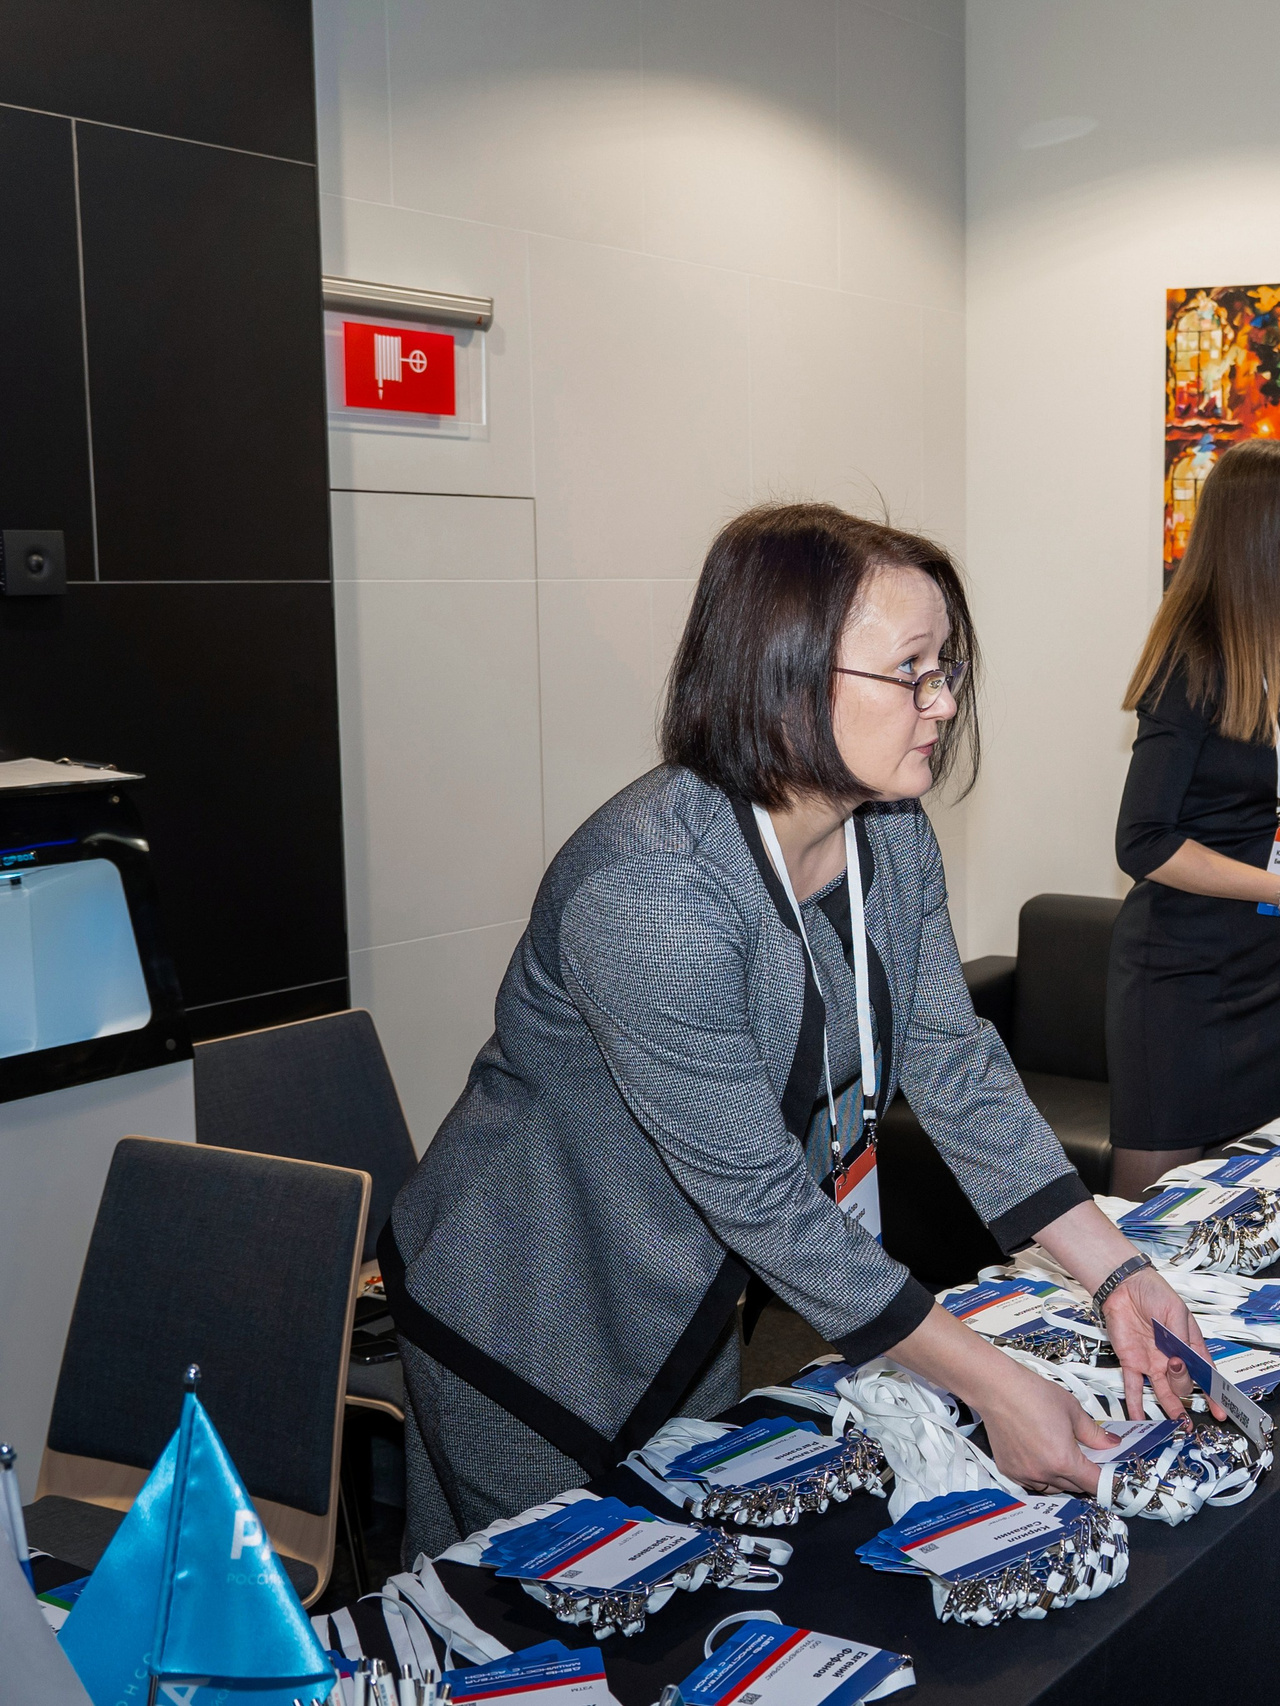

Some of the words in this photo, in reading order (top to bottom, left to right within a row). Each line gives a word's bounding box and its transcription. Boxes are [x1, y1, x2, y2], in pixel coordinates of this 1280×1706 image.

[774, 1441, 819, 1460] Рагозина
[993, 1520, 1042, 1541] Сабанин
[1007, 1525, 1050, 1543] Кирилл
[628, 1535, 676, 1562] Таразанов
[658, 1536, 687, 1553] Антон
[813, 1647, 853, 1678] Фофанов
[832, 1651, 869, 1679] Евгений
